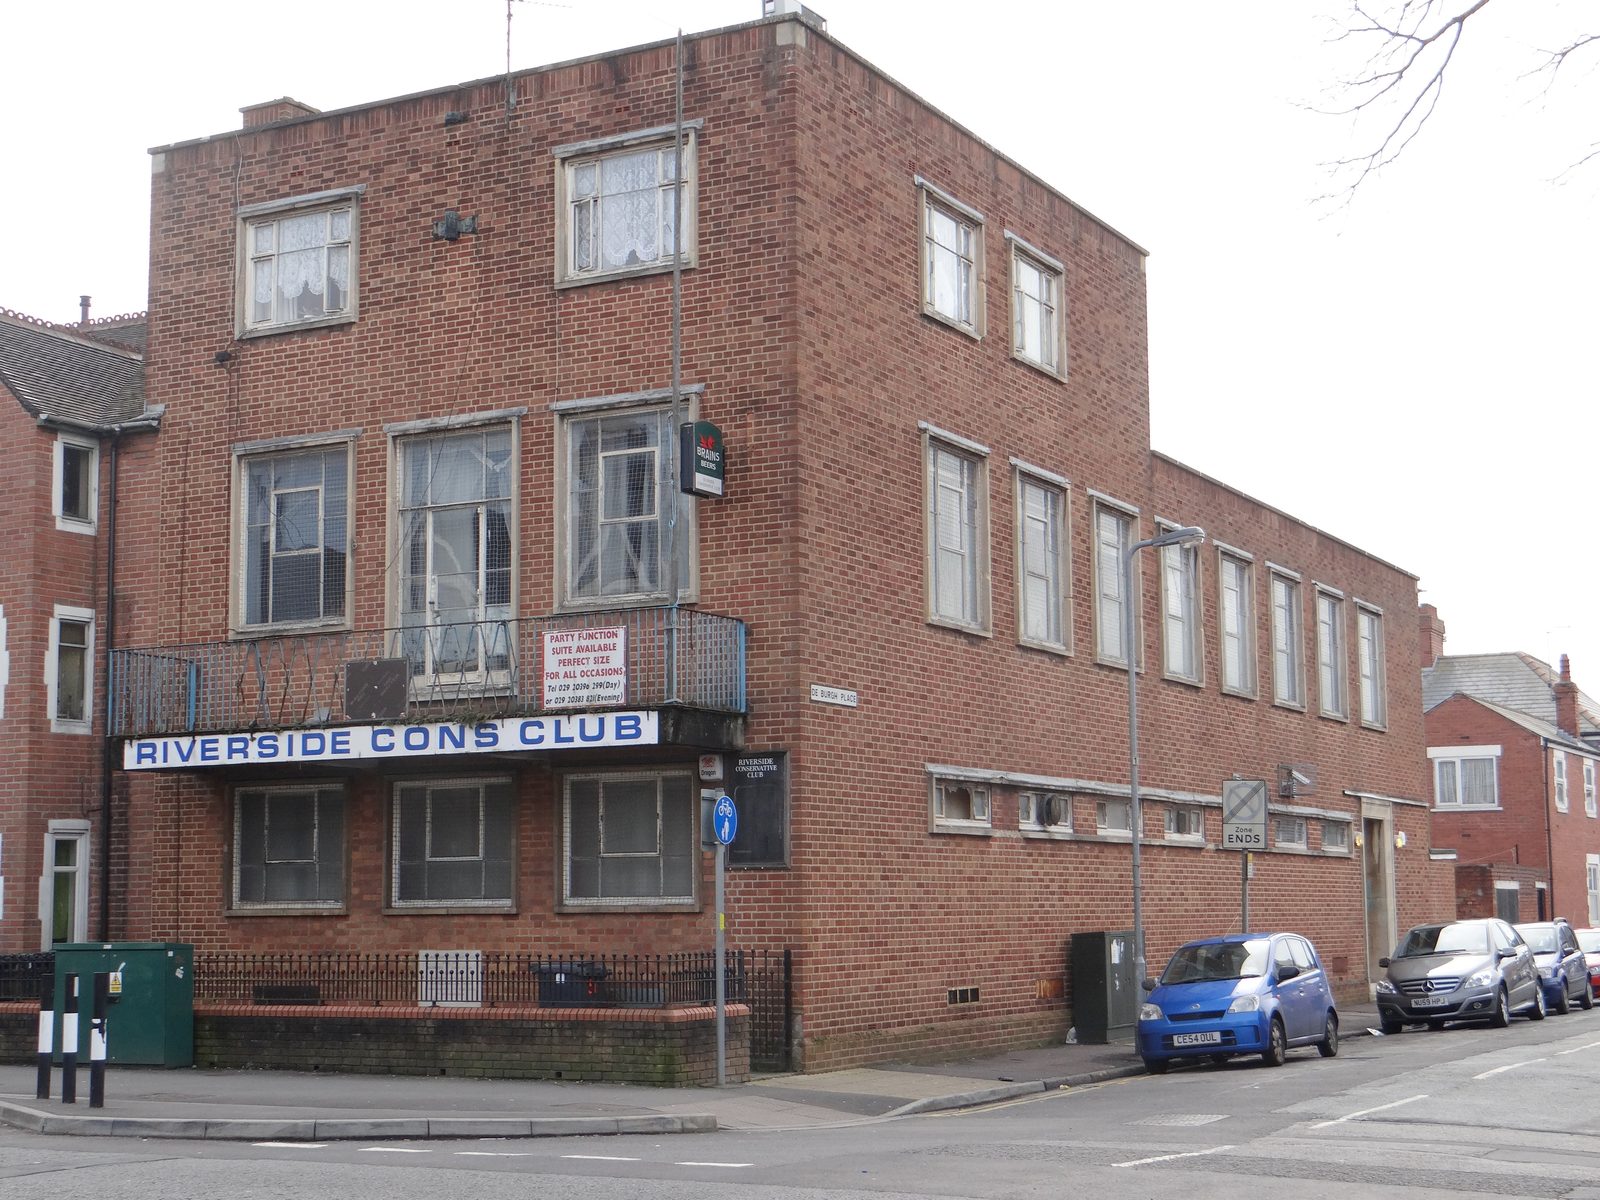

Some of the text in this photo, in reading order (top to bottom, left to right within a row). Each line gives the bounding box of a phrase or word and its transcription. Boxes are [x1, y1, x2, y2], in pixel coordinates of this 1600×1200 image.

[697, 446, 720, 461] BRAINS
[700, 460, 716, 470] BEERS
[550, 630, 619, 643] PARTY FUNCTION
[551, 642, 617, 656] SUITE AVAILABLE
[558, 655, 611, 667] PERFECT SIZE
[545, 667, 623, 680] FOR ALL OCCASIONS
[547, 685, 557, 693] Tel
[558, 684, 571, 692] 029
[811, 688, 856, 702] DE BURGH PLACE
[136, 714, 643, 765] RIVERSIDE CONS CLUB
[735, 764, 778, 772] CONSERVATIVE
[1228, 834, 1260, 843] ENDS
[1176, 1034, 1199, 1044] CE54
